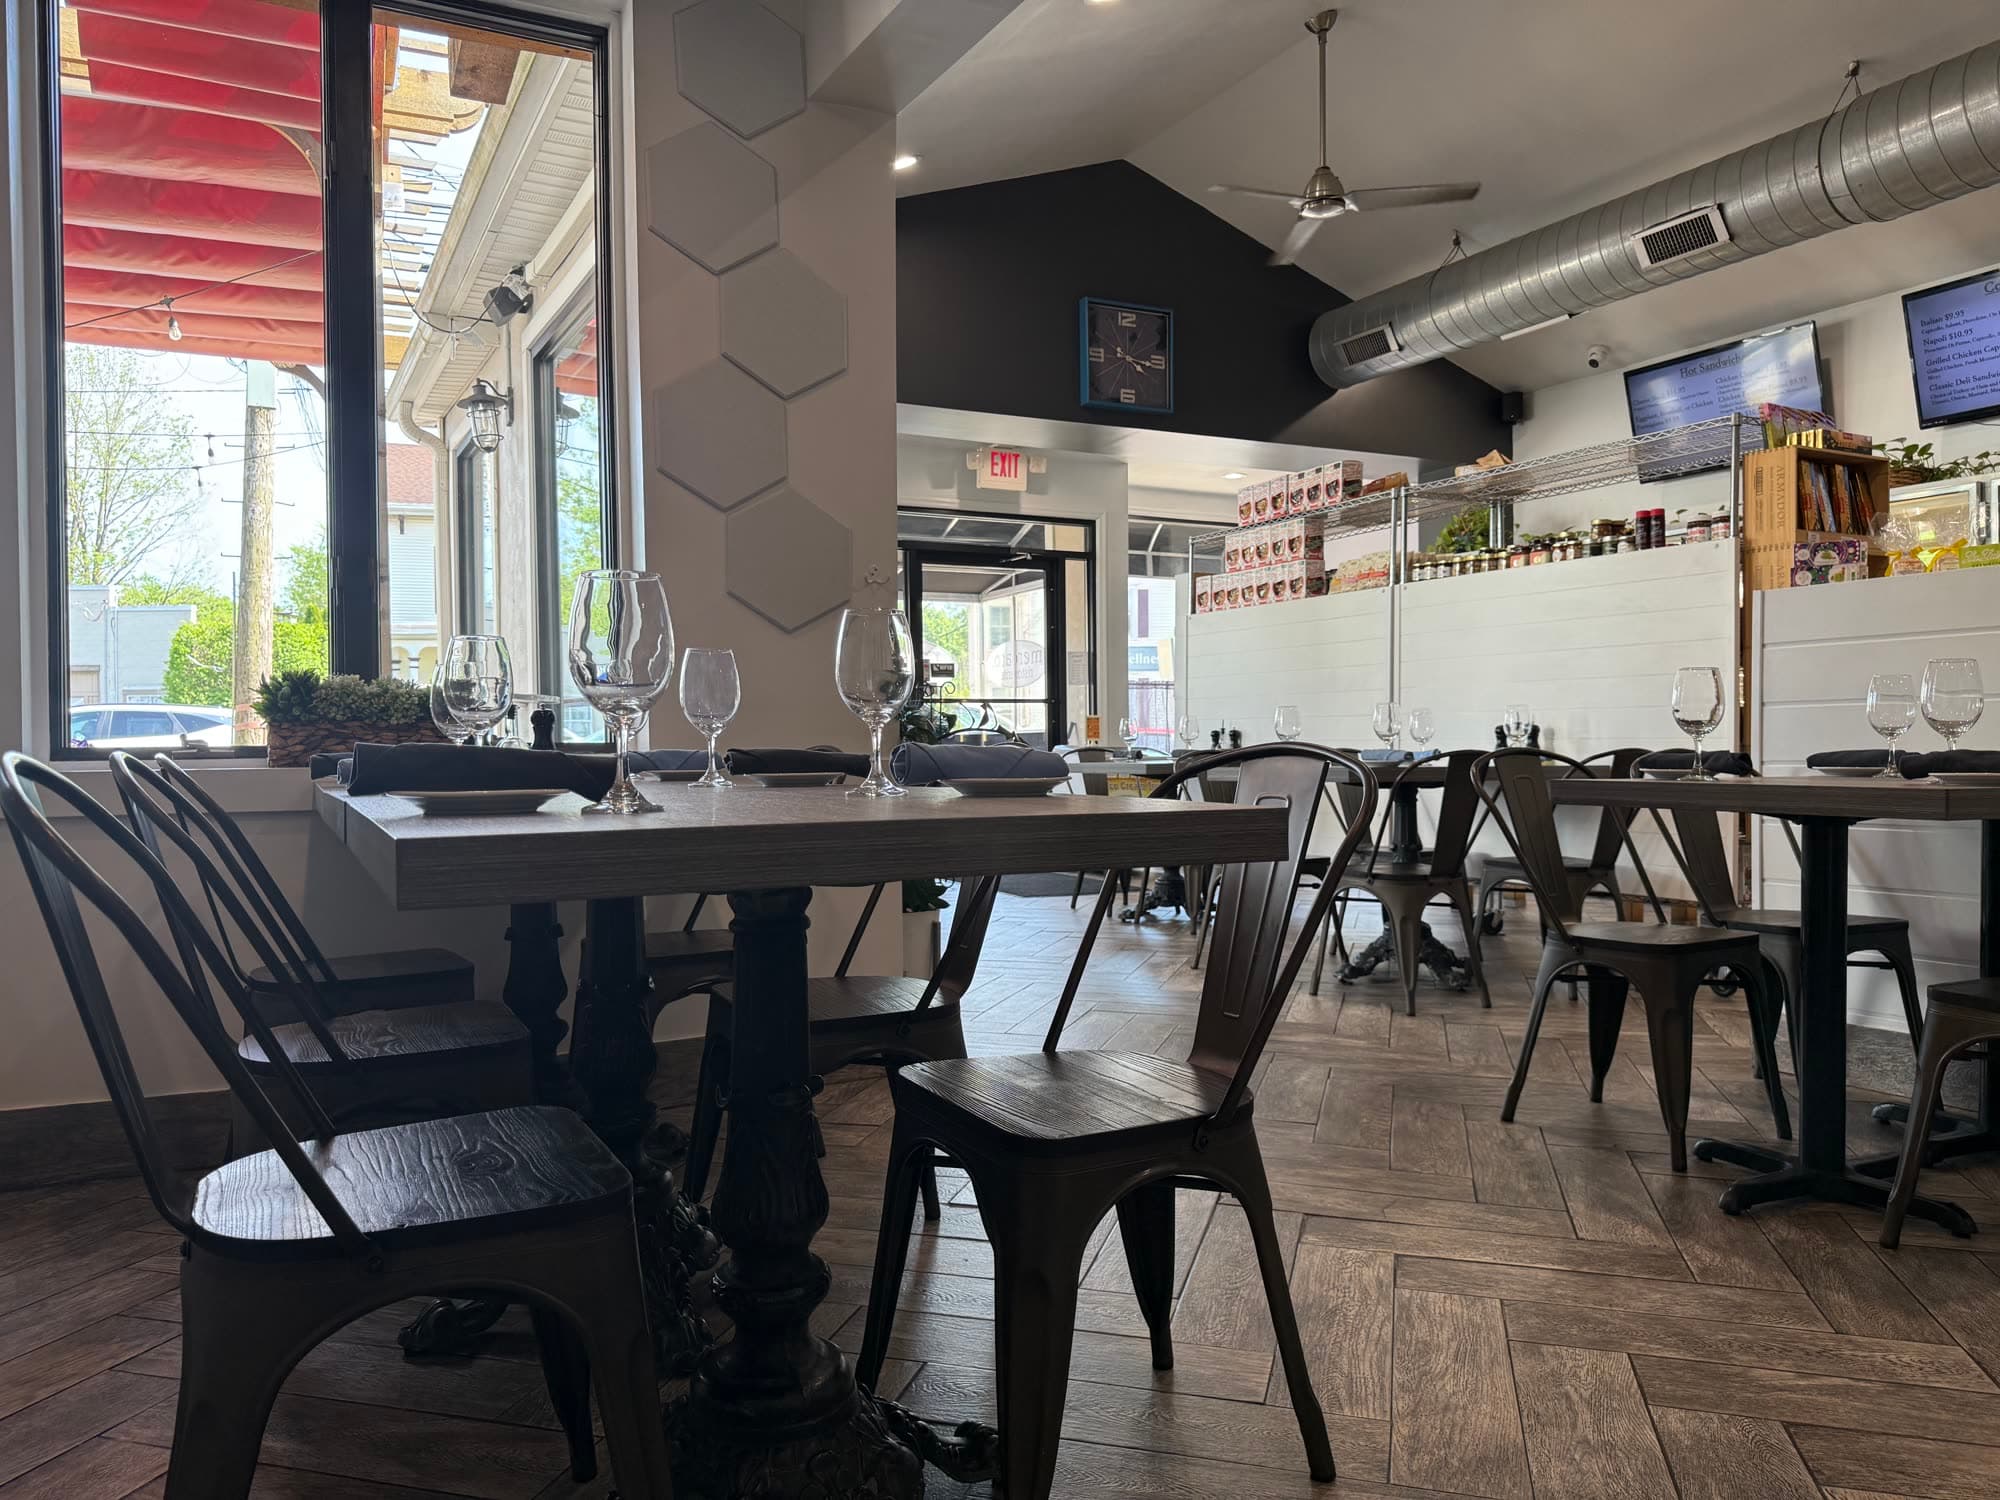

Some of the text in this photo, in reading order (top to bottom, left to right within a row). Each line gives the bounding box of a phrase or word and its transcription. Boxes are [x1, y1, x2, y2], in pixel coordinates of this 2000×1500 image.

[1920, 309, 1965, 327] Italian $9.95
[1923, 335, 1947, 346] Napoli
[1948, 328, 1973, 339] $10.95
[1926, 355, 1951, 366] Grilled
[1952, 349, 1982, 360] Chicken
[1680, 364, 1698, 379] Hot
[1956, 377, 1971, 386] Deli
[990, 451, 1021, 479] EXIT
